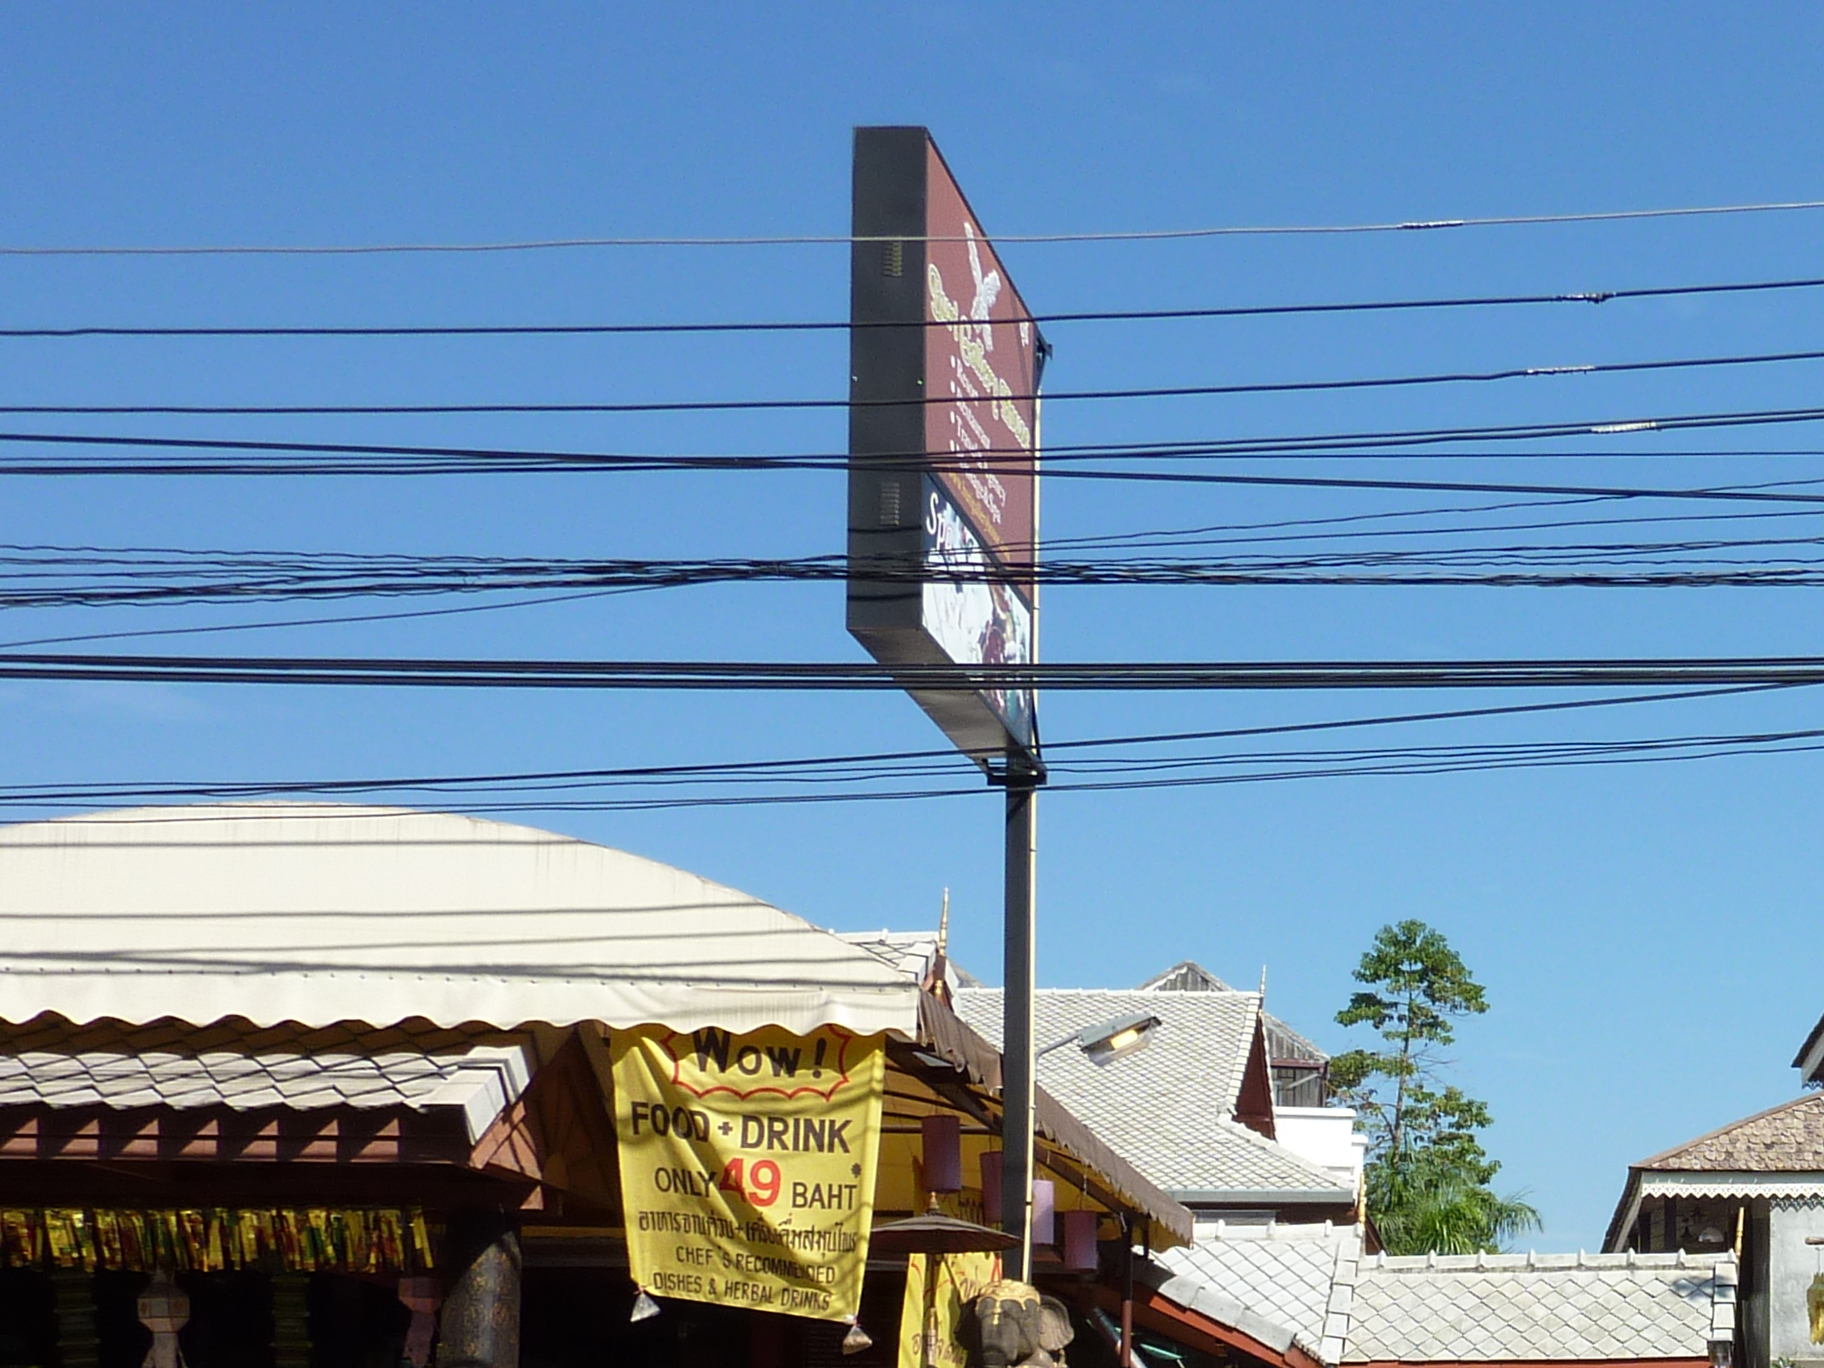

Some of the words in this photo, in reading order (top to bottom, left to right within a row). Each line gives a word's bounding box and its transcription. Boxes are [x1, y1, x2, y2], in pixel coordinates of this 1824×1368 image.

[631, 1102, 710, 1143] FOOD
[740, 1115, 852, 1153] DRINK
[655, 1167, 716, 1198] ONLY
[719, 1157, 781, 1207] 49
[735, 1252, 836, 1285] RECOMMENDED
[653, 1272, 703, 1293] DISHES
[708, 1278, 717, 1296] &
[724, 1281, 774, 1304] HERBAL
[781, 1288, 832, 1311] DRINKS
